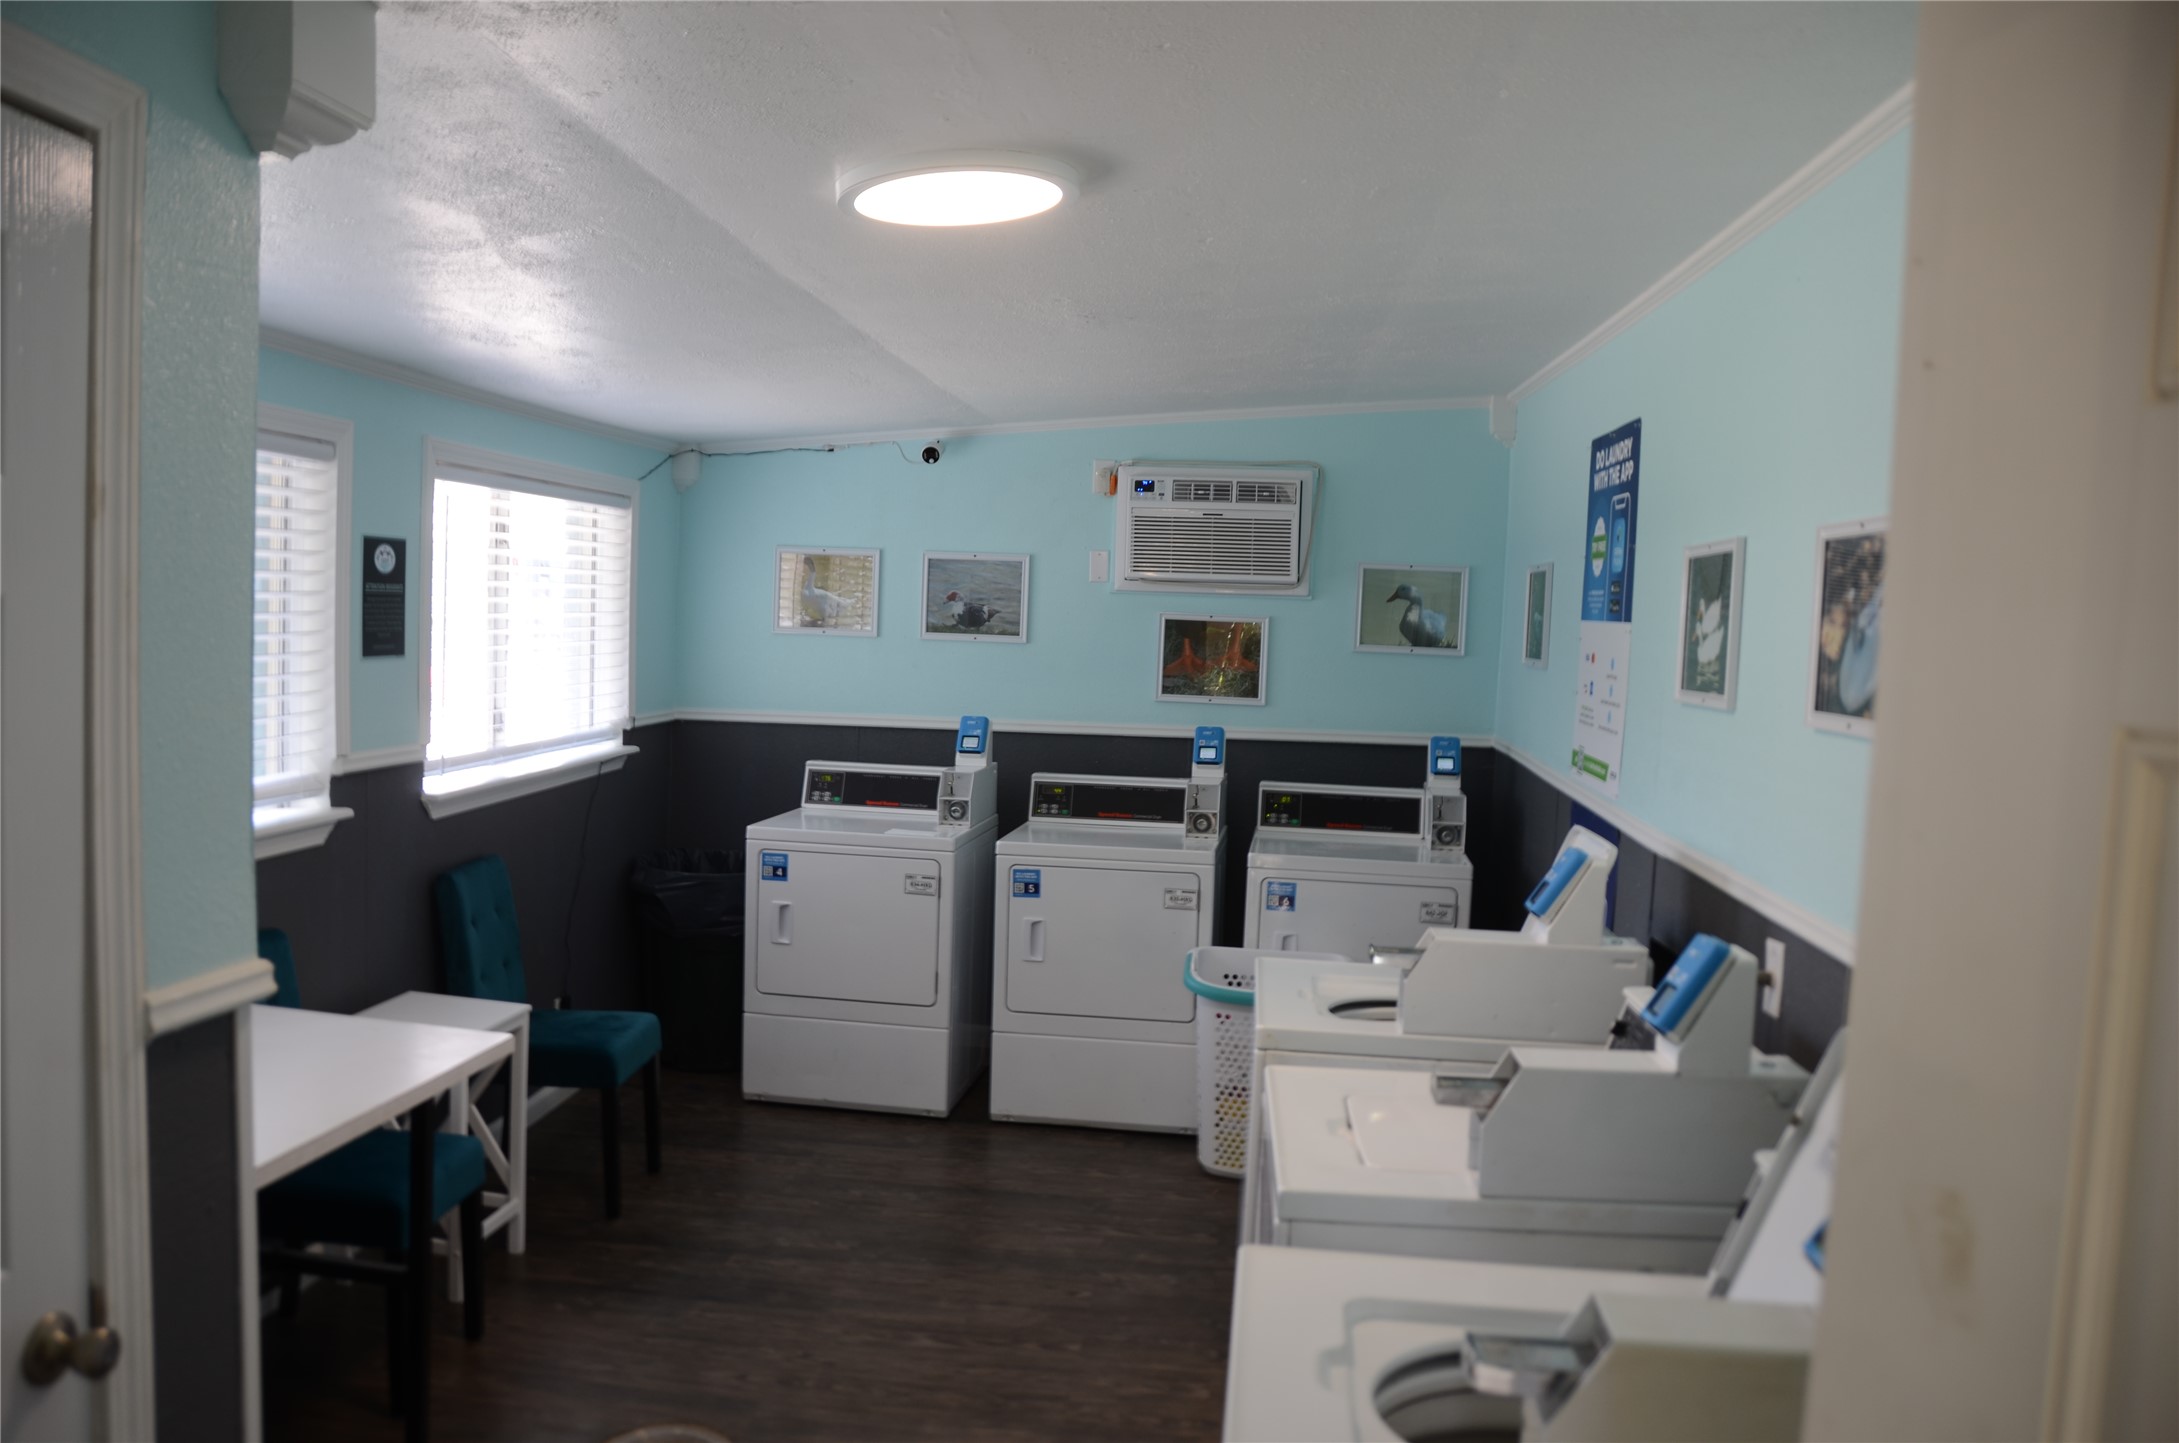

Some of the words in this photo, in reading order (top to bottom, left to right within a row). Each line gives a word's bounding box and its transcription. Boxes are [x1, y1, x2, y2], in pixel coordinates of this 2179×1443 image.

[1596, 448, 1605, 471] DO
[1605, 436, 1633, 467] LAUNDRY
[1594, 468, 1608, 491] WITH
[1609, 464, 1620, 487] THE
[1620, 459, 1634, 483] APP
[776, 867, 783, 876] 4
[1028, 884, 1035, 893] 5
[1284, 897, 1290, 905] 6
